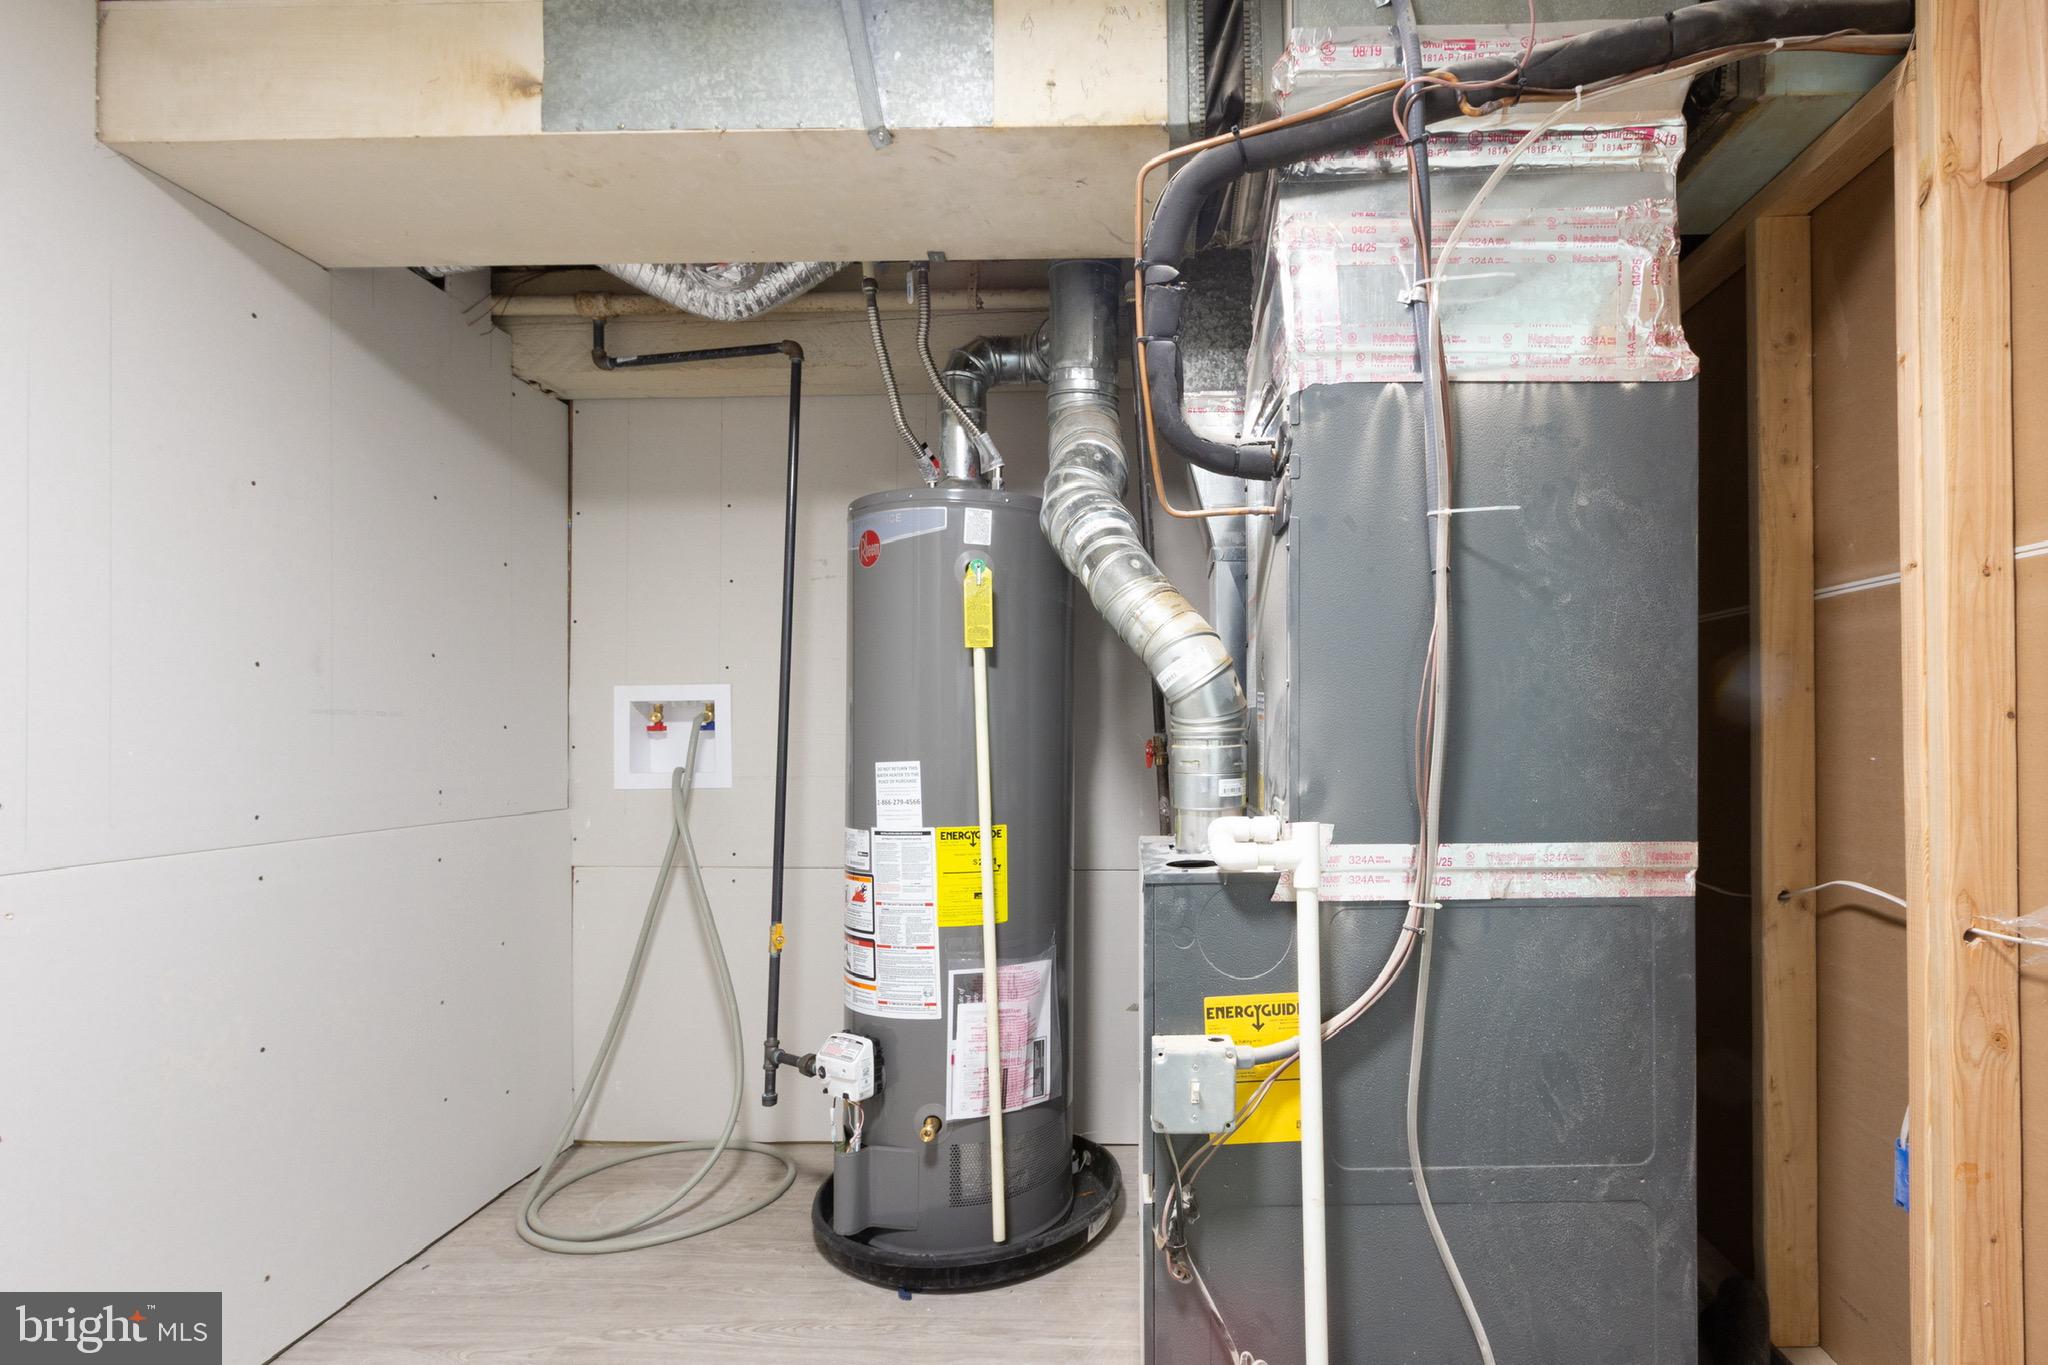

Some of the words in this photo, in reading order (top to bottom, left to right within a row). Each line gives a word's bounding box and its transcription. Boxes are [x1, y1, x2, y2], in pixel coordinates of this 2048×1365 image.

[1352, 45, 1382, 58] 08/19
[1351, 243, 1376, 253] 04/25
[940, 829, 1002, 841] ENERGYGDE
[1348, 855, 1375, 865] 324A
[1348, 875, 1375, 884] 324A
[1206, 1003, 1299, 1020] ENERGYGUID
